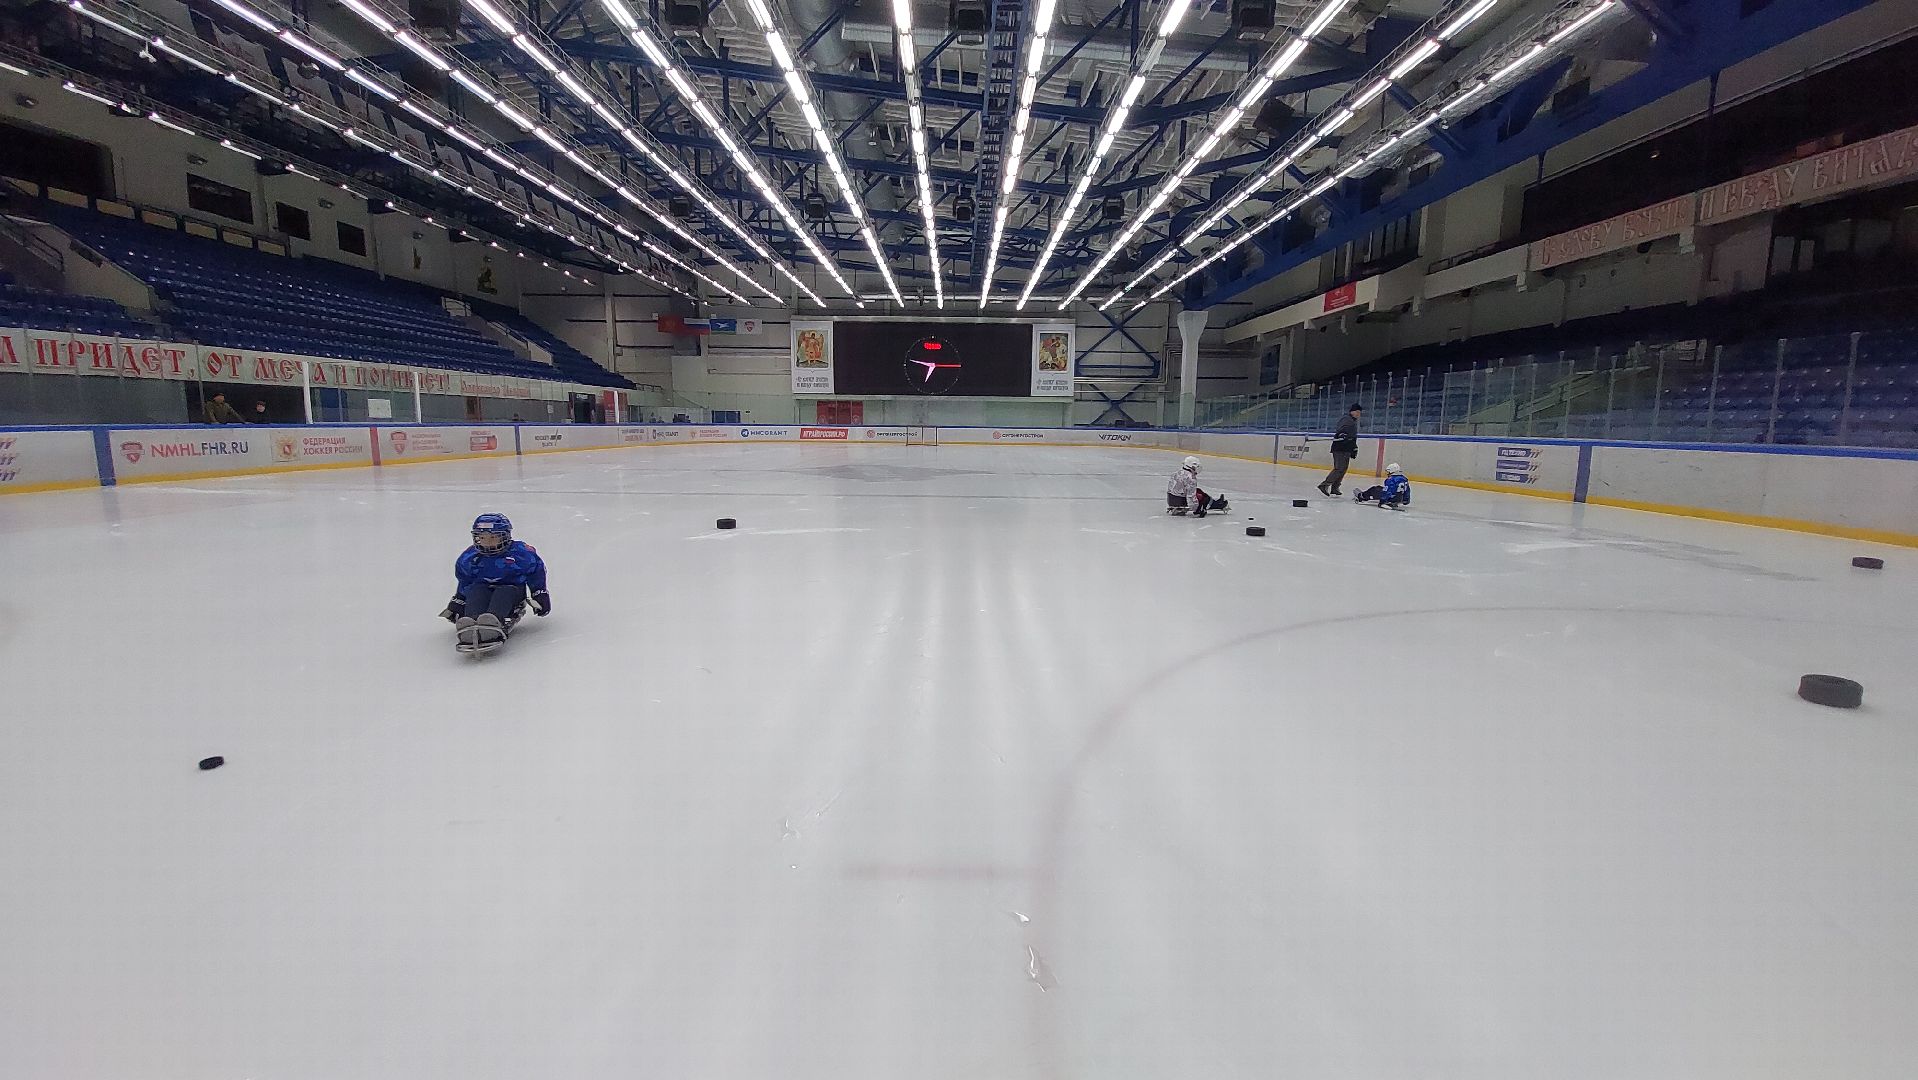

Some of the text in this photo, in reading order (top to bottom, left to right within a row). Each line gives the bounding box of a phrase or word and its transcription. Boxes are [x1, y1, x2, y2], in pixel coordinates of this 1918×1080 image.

[206, 351, 243, 379] ОТ
[332, 364, 348, 386] И
[303, 437, 346, 446] ФЕДЕРАЦИЯ
[151, 440, 249, 457] NMHL.FHR.RU
[303, 445, 363, 455] ХОККЕЯ РОССИИ
